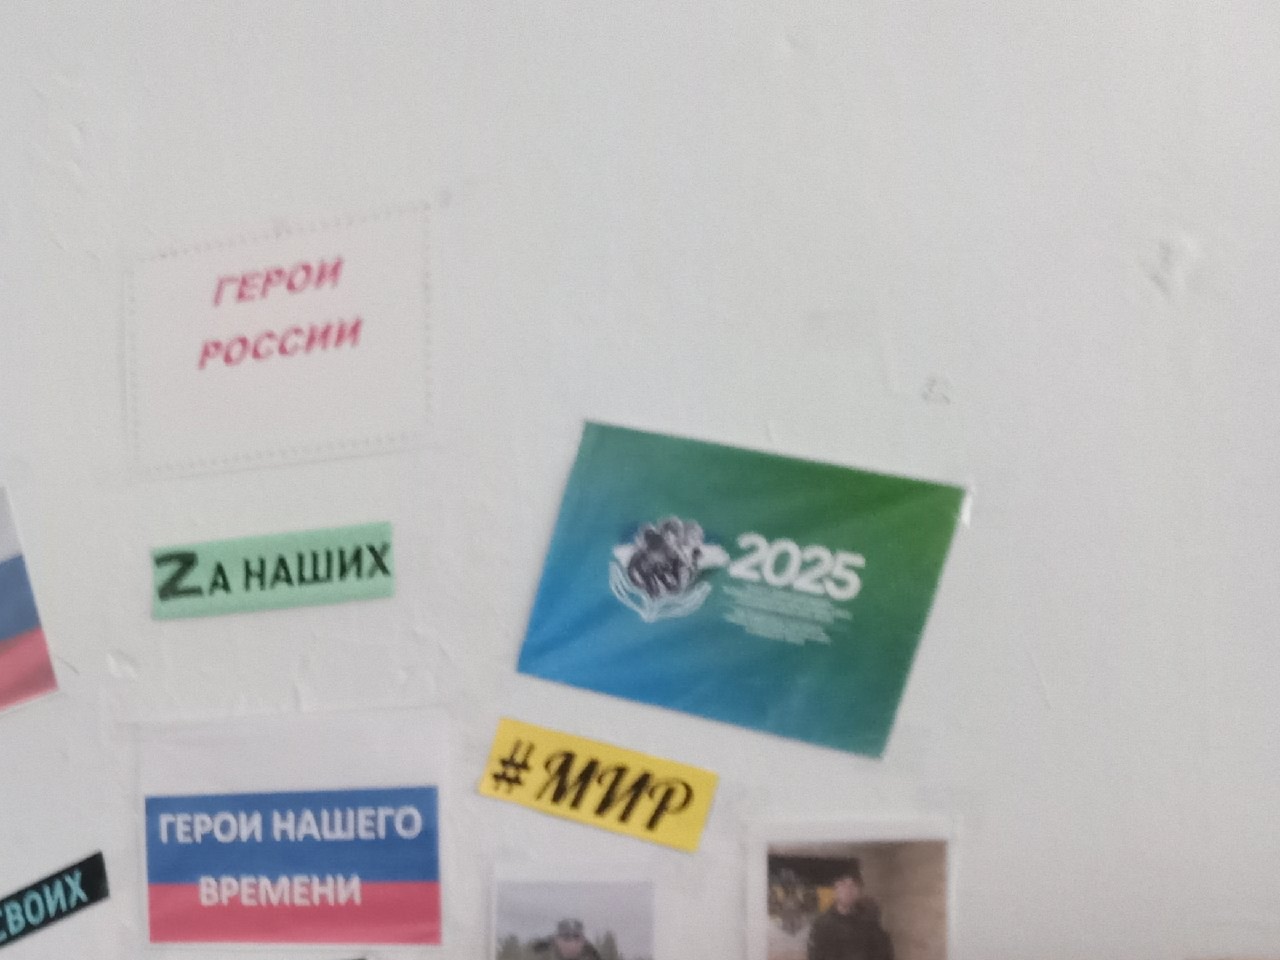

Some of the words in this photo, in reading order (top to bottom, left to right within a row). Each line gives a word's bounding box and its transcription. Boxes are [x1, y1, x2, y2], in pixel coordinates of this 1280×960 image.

[213, 255, 344, 307] ГЕРОИ
[198, 314, 364, 371] РОССИИ
[243, 541, 392, 592] НАШИХ
[727, 532, 866, 601] 2025
[492, 739, 695, 832] #МИР
[158, 809, 263, 844] ГЕРОИ
[272, 804, 423, 842] НАШЕГО
[198, 873, 362, 907] ВРЕМЕНИ
